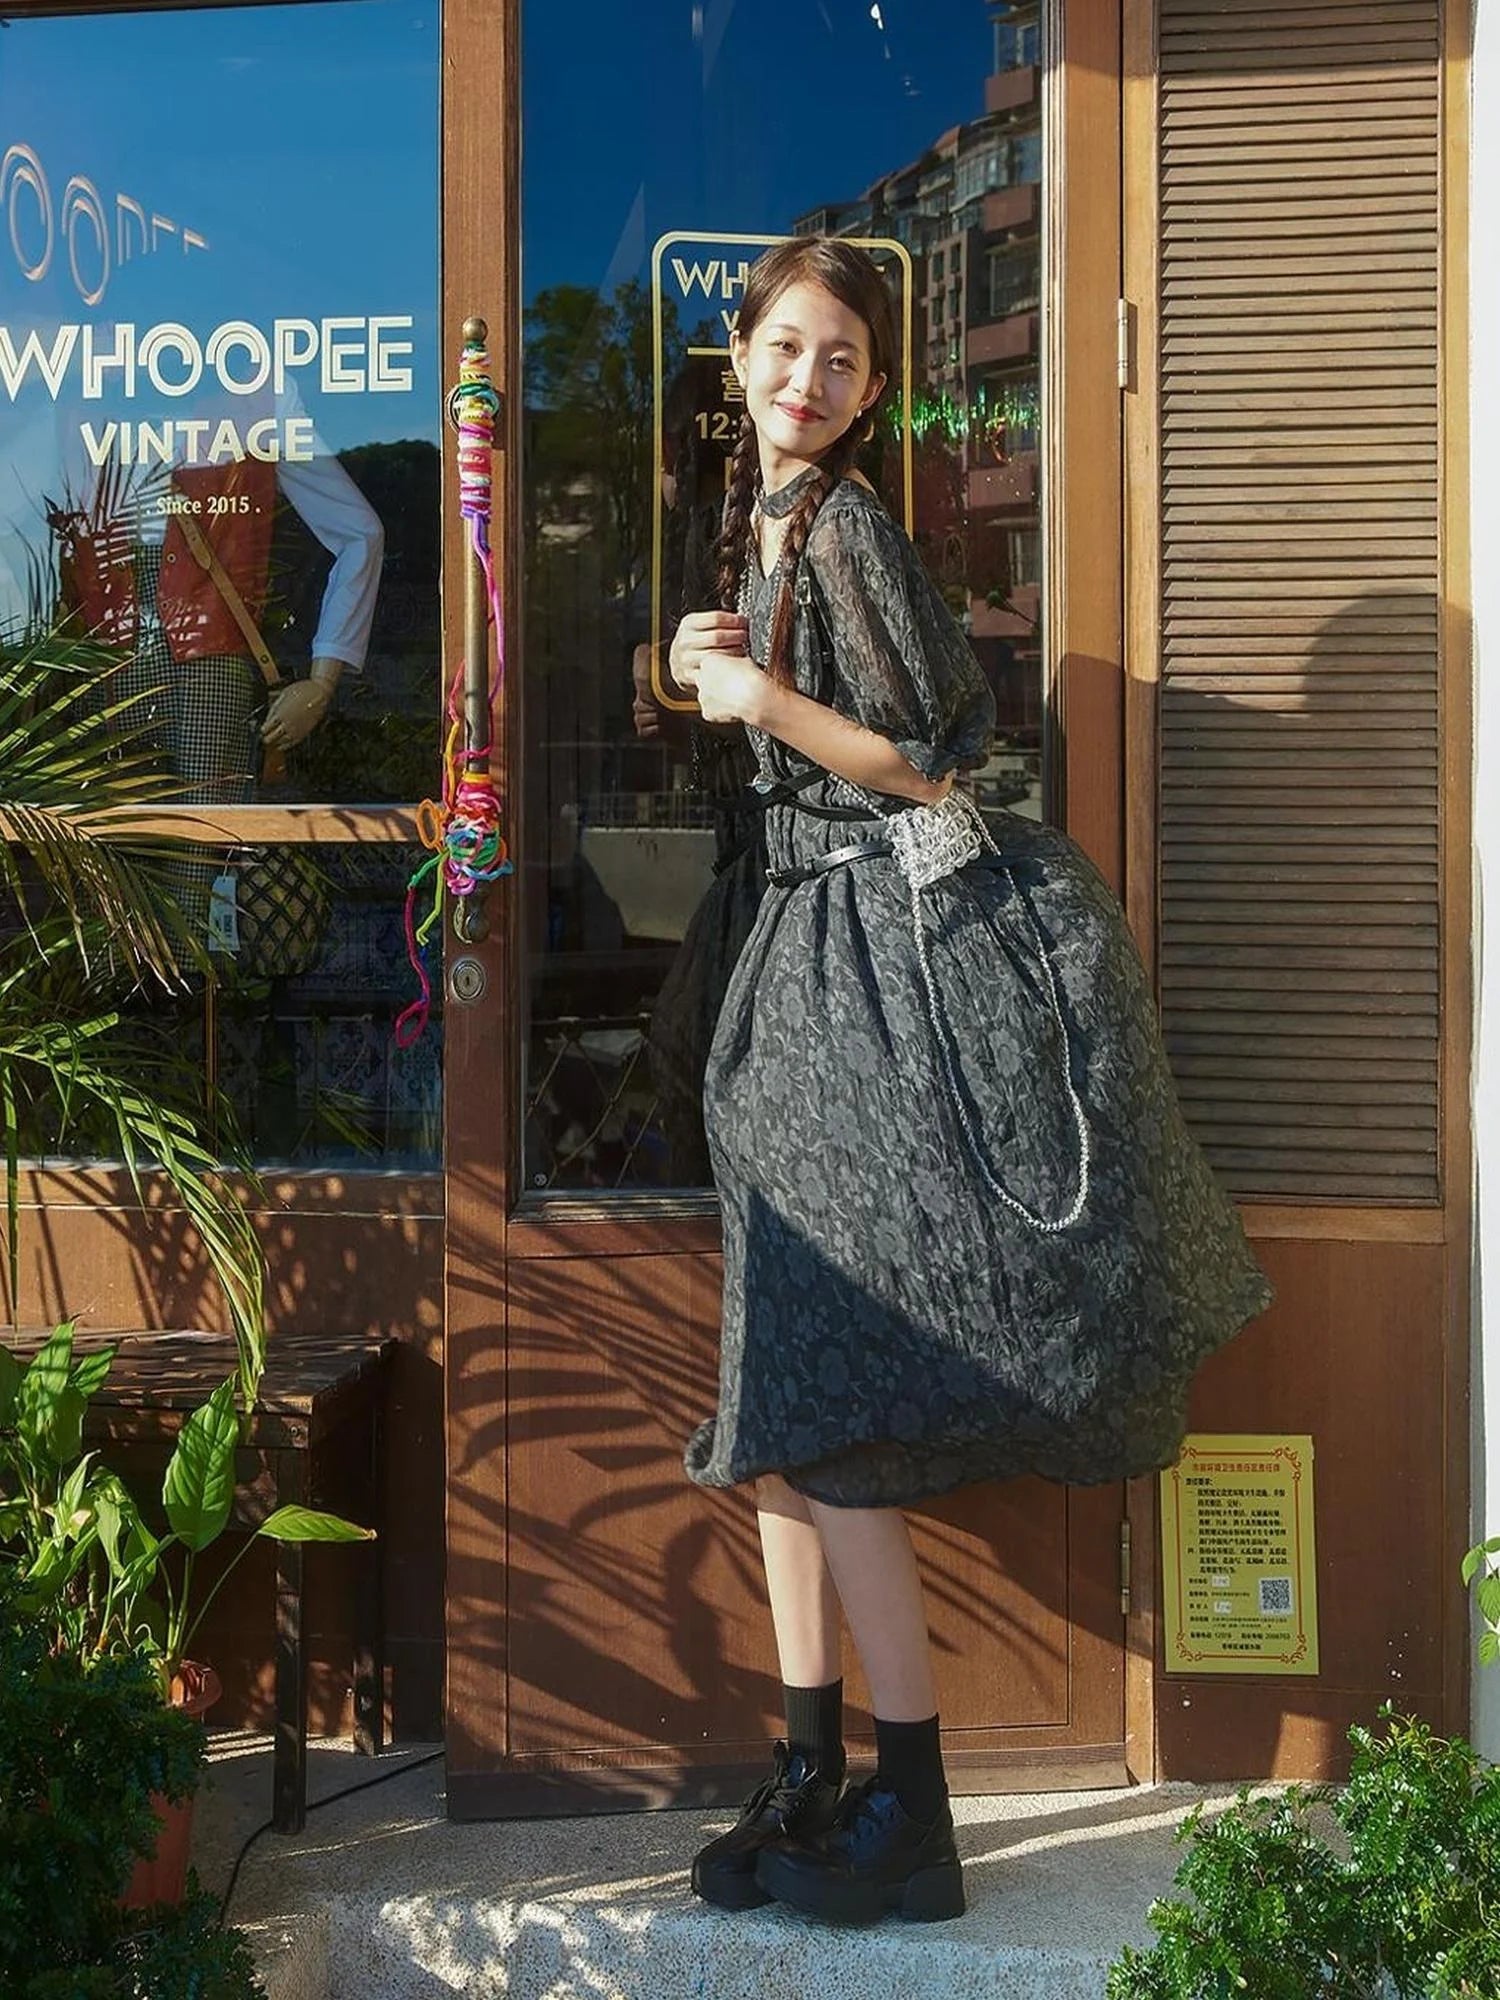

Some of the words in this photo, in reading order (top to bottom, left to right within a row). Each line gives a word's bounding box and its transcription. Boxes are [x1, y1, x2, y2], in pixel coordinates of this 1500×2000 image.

[0, 315, 413, 403] WHOOPEE
[80, 418, 314, 467] VINTAGE
[156, 496, 202, 515] Since
[207, 496, 250, 514] 2015
